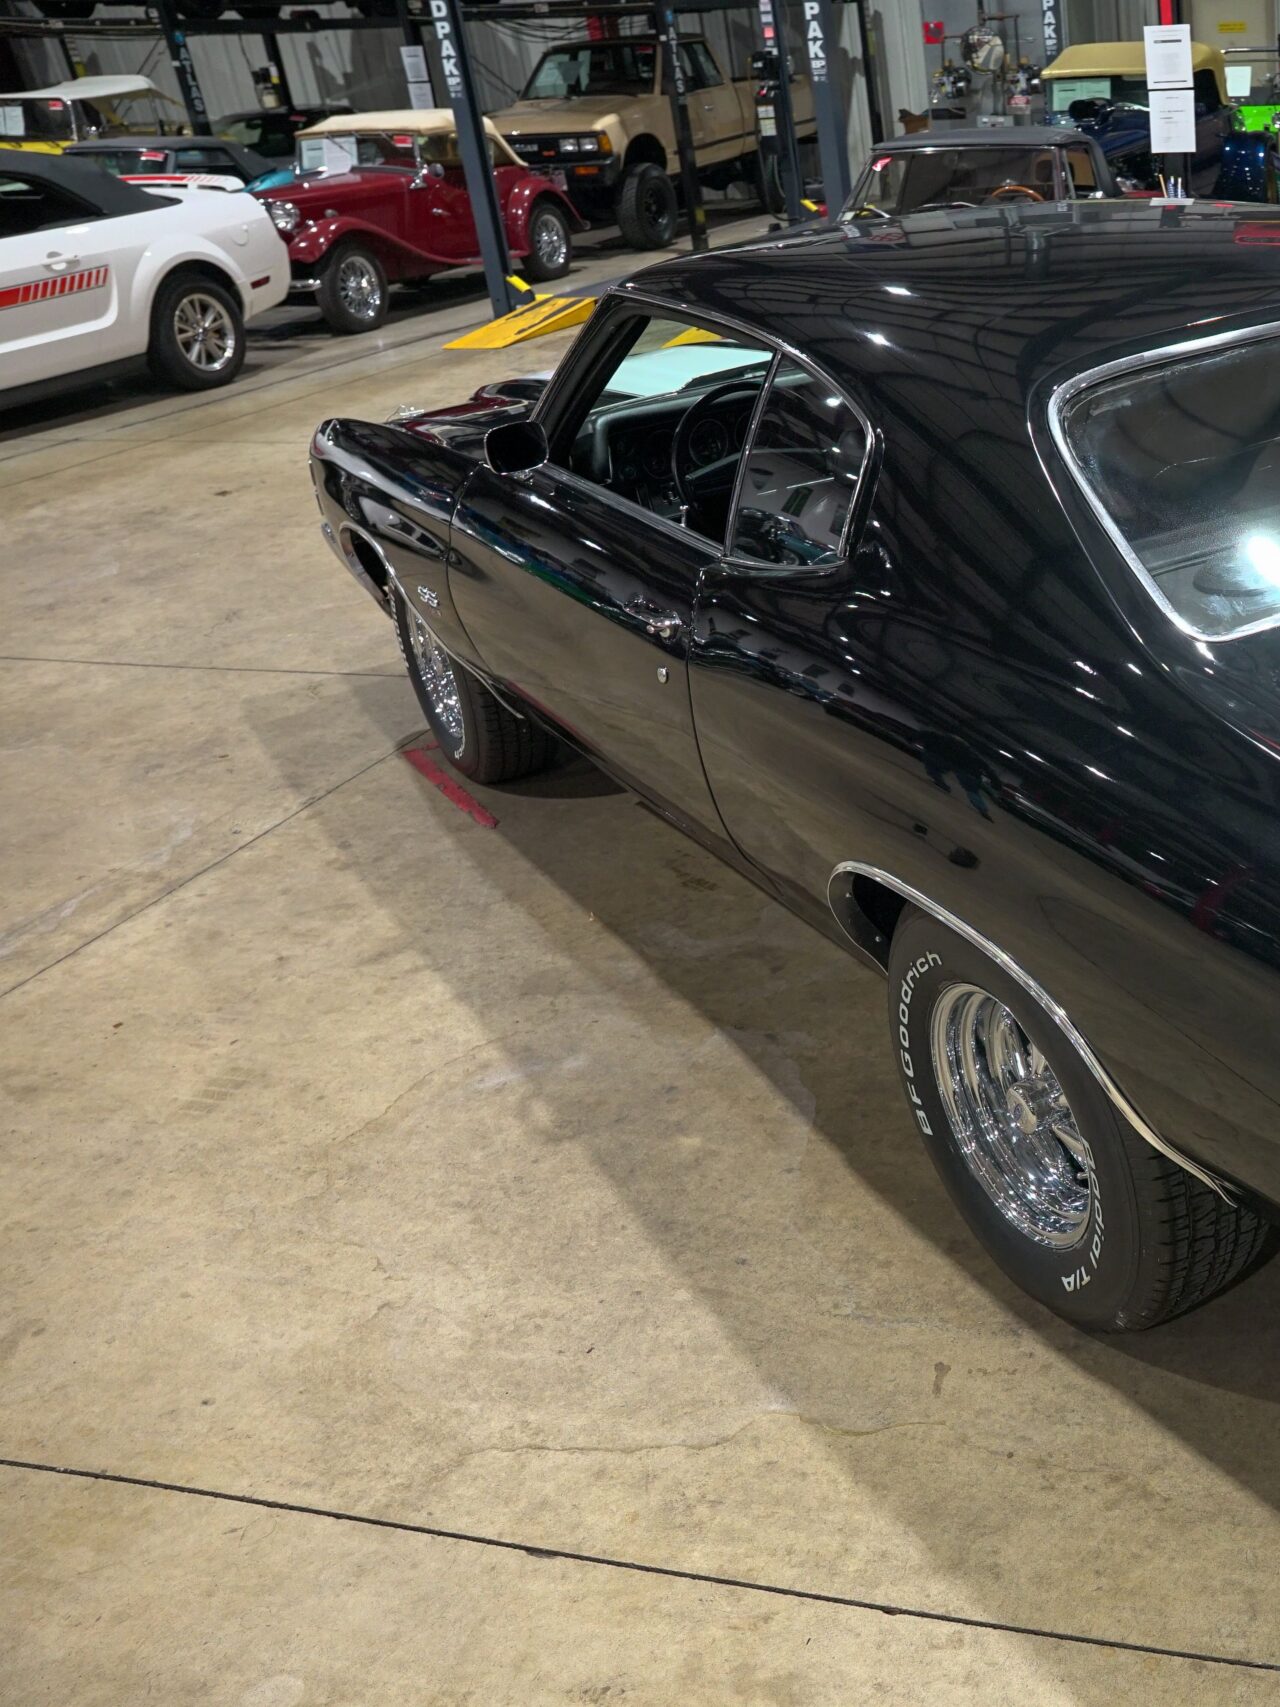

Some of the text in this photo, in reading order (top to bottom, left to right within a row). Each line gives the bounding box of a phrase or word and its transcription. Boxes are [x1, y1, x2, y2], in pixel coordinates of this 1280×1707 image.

[668, 26, 685, 93] ATLAS
[803, 1, 826, 58] PAK
[1061, 1135, 1105, 1292] Radial T/A
